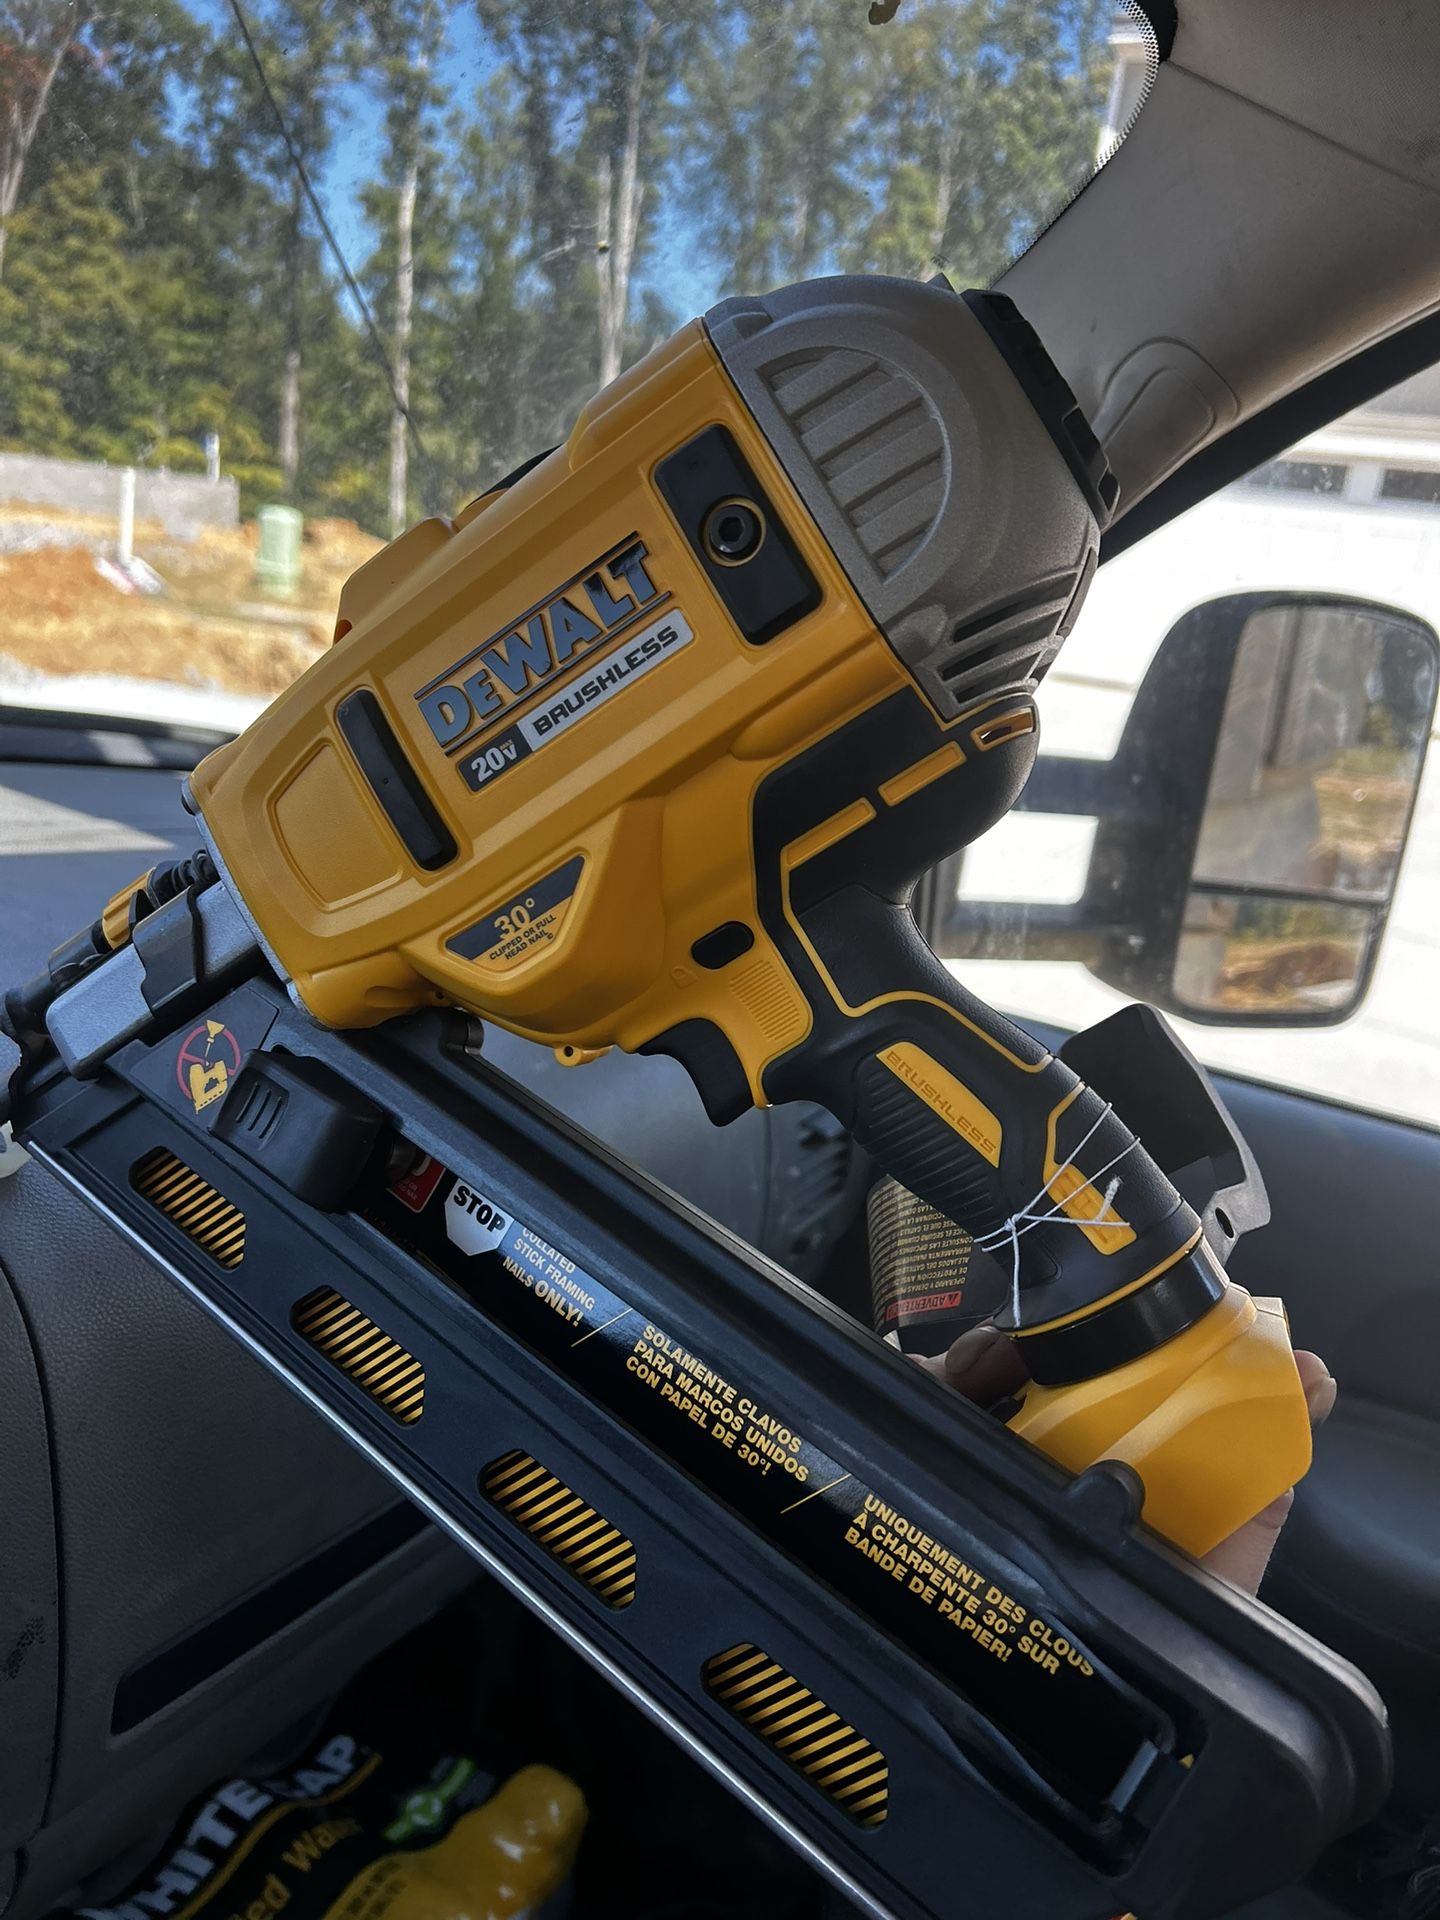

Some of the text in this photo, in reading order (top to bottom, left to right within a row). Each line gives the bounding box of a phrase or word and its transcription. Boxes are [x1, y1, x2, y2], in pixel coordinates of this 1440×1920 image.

[532, 626, 678, 737] BRUSHLESS
[489, 914, 557, 961] CLIPPED OR FULL
[505, 929, 549, 960] HEAD NAIL
[885, 1051, 996, 1155] BRUSHLESS
[453, 1185, 506, 1233] STOP
[502, 1256, 584, 1328] NAILS ONLY!
[513, 1238, 595, 1311] STICK FRAMING
[626, 1356, 661, 1389] CON
[660, 1382, 708, 1429] PAPEL
[711, 1422, 737, 1449] DE
[634, 1340, 809, 1482] PARA MARCOS UNIDOS
[643, 1325, 802, 1454] SOLAMENTE CLAVOS
[844, 1526, 1013, 1663] BANDE DE PAPIER!
[863, 1493, 1095, 1677] UNIQUEMENT DES CLOUS
[871, 1524, 982, 1615] CHARPENTE
[982, 1609, 1016, 1634] 30°
[1017, 1635, 1061, 1675] SUR
